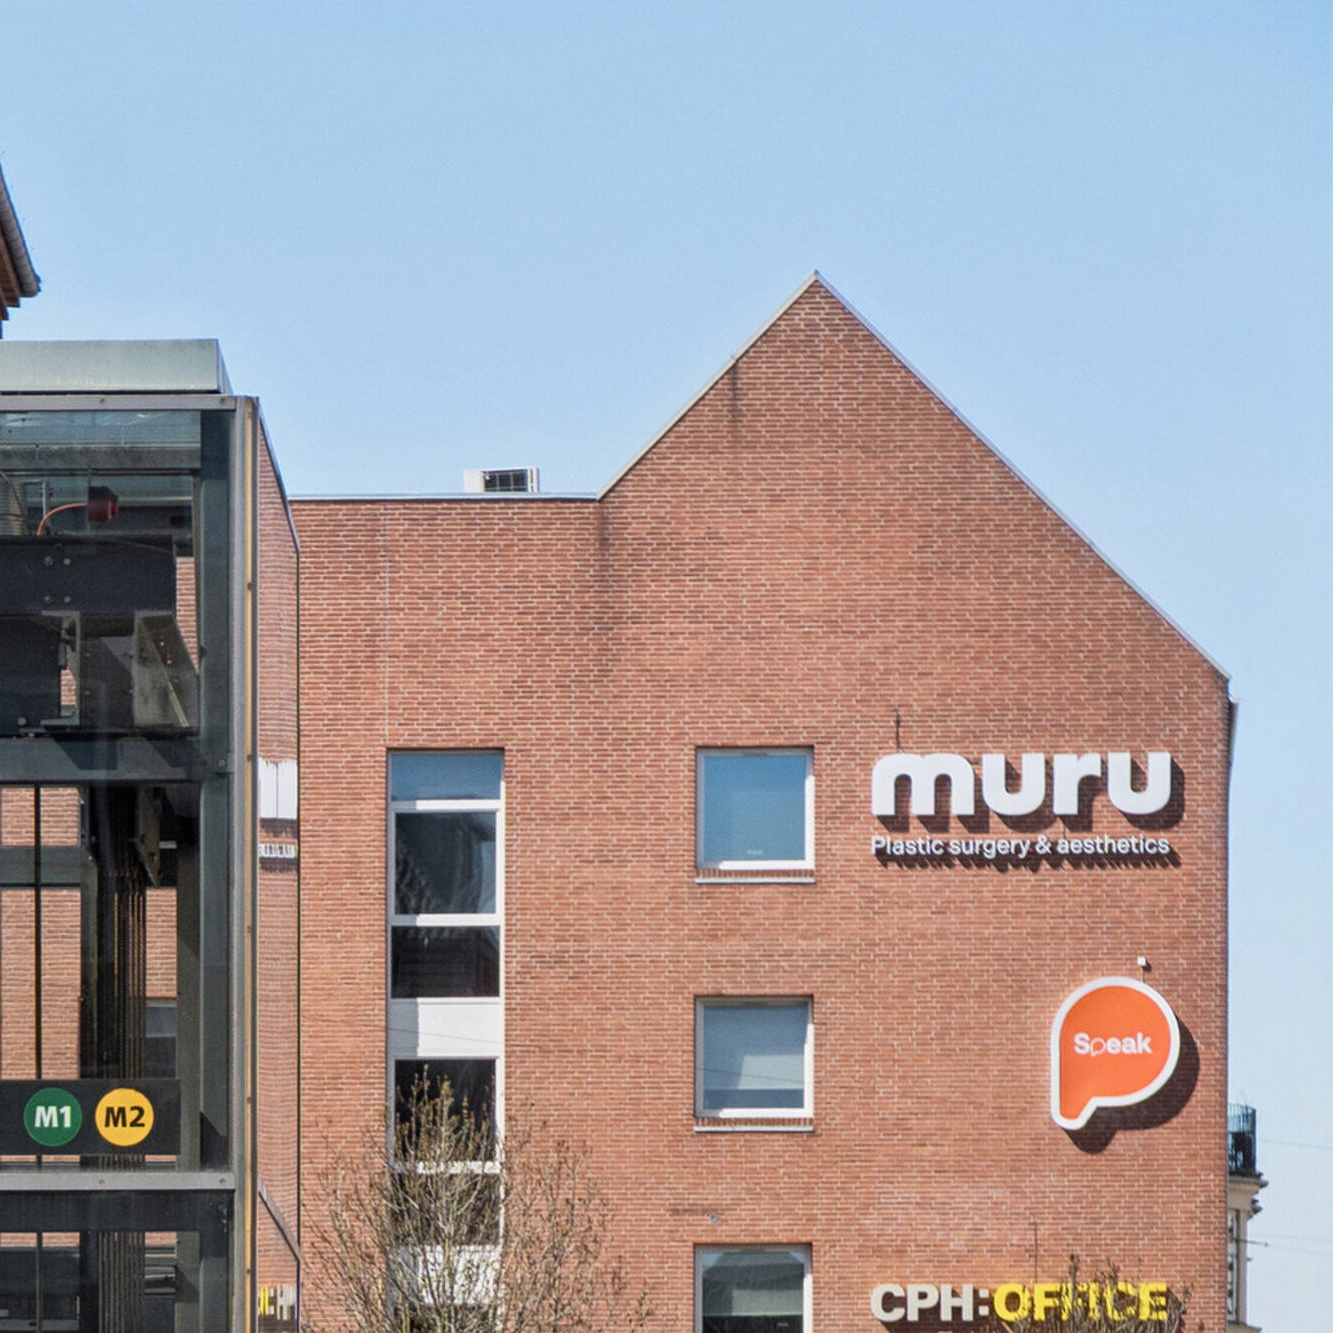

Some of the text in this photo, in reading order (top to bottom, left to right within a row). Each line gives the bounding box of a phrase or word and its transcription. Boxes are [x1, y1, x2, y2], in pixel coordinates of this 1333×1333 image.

[871, 751, 1172, 816] muru
[871, 833, 1170, 860] Plastic surgery & aesthetics
[1074, 1031, 1153, 1057] Speak
[34, 1105, 146, 1128] M1 M2
